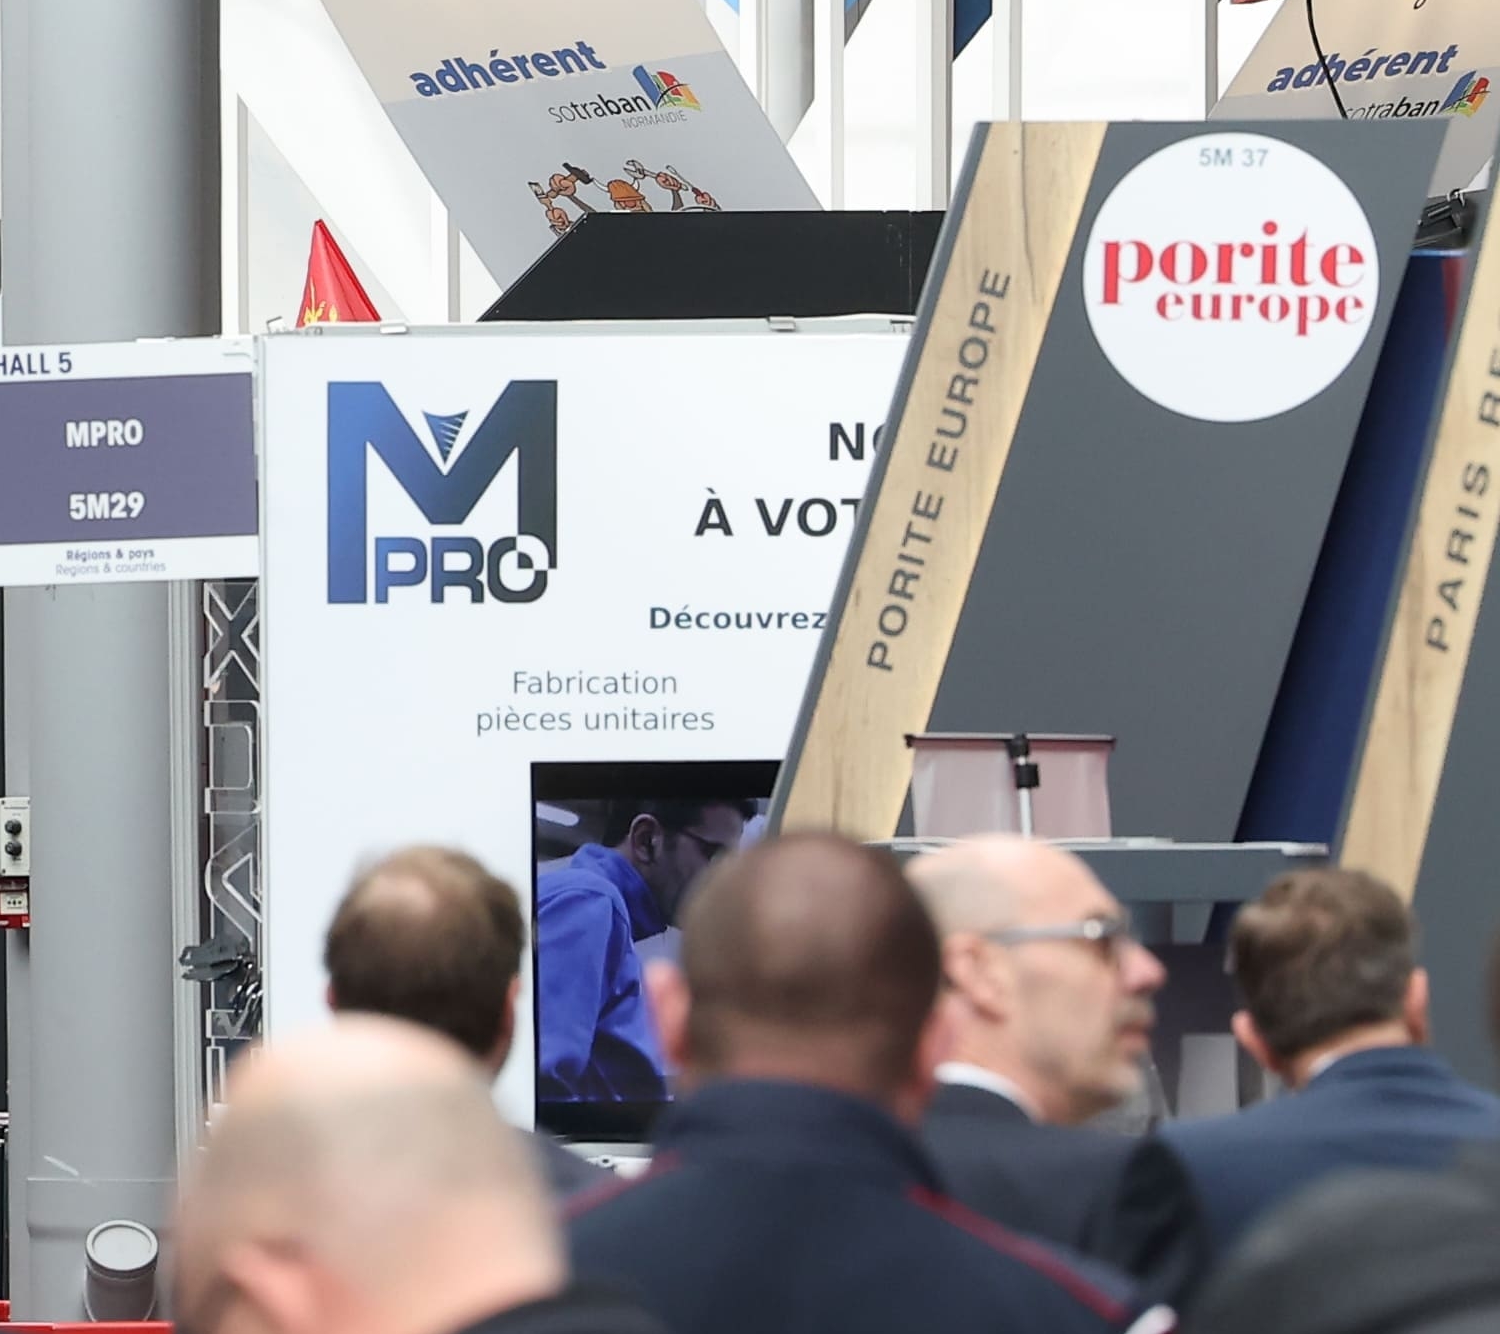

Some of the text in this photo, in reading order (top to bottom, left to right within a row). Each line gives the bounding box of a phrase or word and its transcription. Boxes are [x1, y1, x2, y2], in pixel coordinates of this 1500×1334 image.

[409, 39, 607, 98] adhérent
[1267, 44, 1459, 93] adhérent
[547, 92, 649, 125] sotraban
[622, 108, 687, 129] NORMANDIE
[1199, 147, 1268, 169] 5M 37
[1099, 220, 1365, 307] porite
[1157, 292, 1364, 336] europe
[59, 352, 72, 373] 5
[66, 419, 143, 448] MPRO
[866, 268, 1012, 673] PORITE EUROPE
[69, 492, 145, 520] 5M29
[694, 488, 733, 537] À
[56, 560, 166, 576] Regions & countries
[67, 548, 154, 561] Régions & pays
[1424, 461, 1492, 654] PARIS
[648, 604, 828, 632] Découvrez
[512, 669, 678, 697] Fabrication
[477, 705, 715, 739] pièces unitaires
